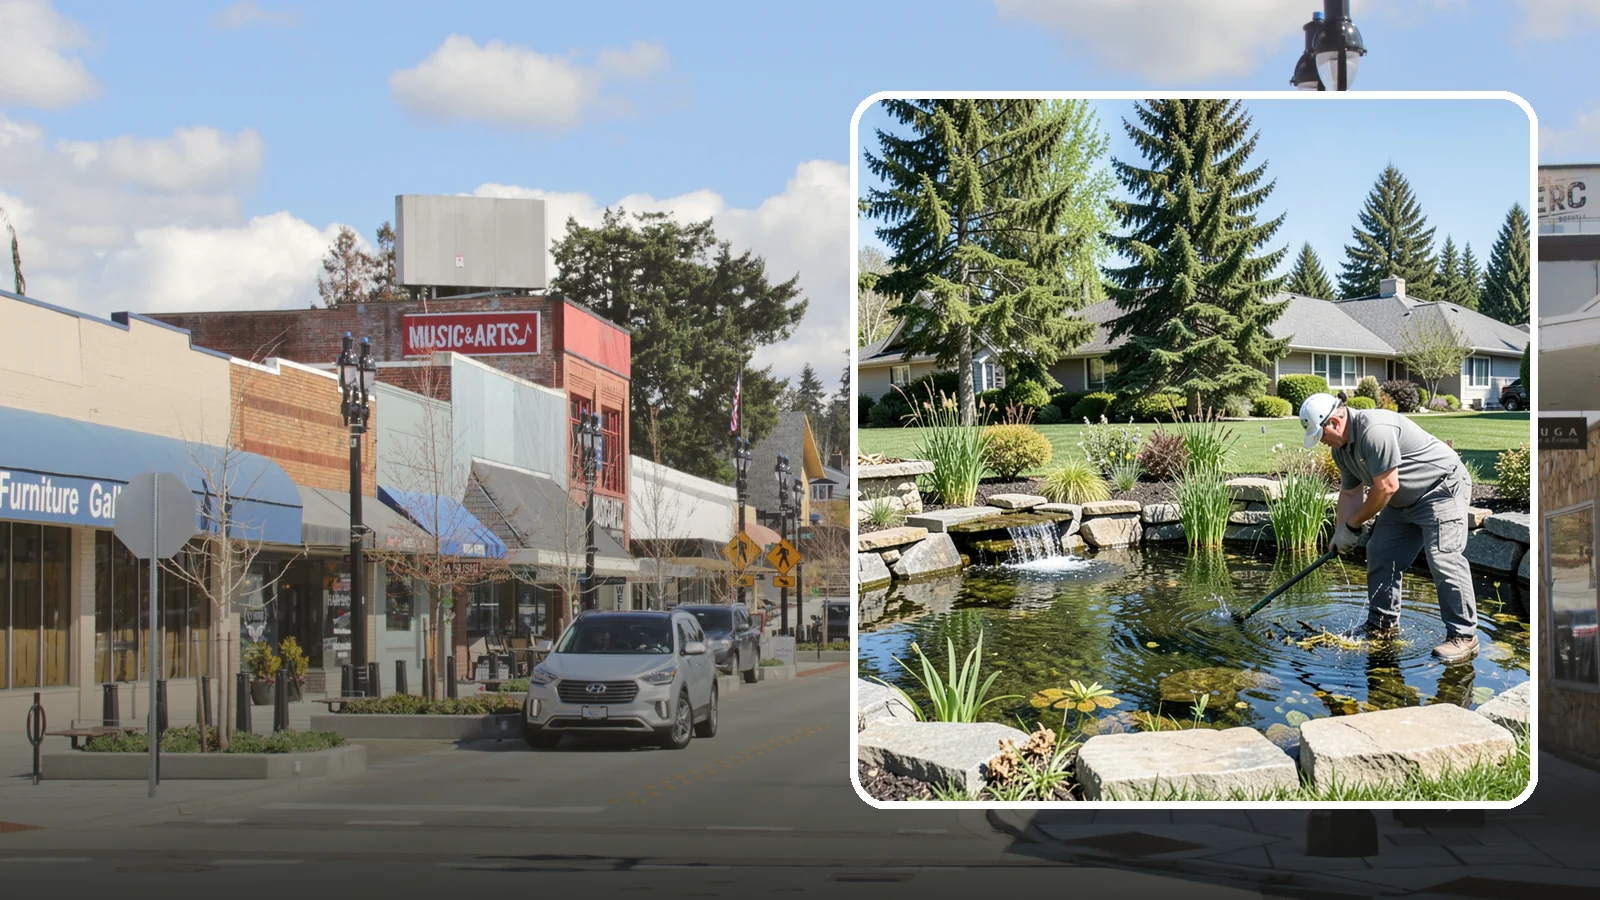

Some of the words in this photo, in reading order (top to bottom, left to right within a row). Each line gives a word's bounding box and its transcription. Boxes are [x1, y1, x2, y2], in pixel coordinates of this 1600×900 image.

[0, 471, 79, 515] Furniture
[89, 482, 121, 519] Gal
[452, 563, 480, 574] SUSHI
